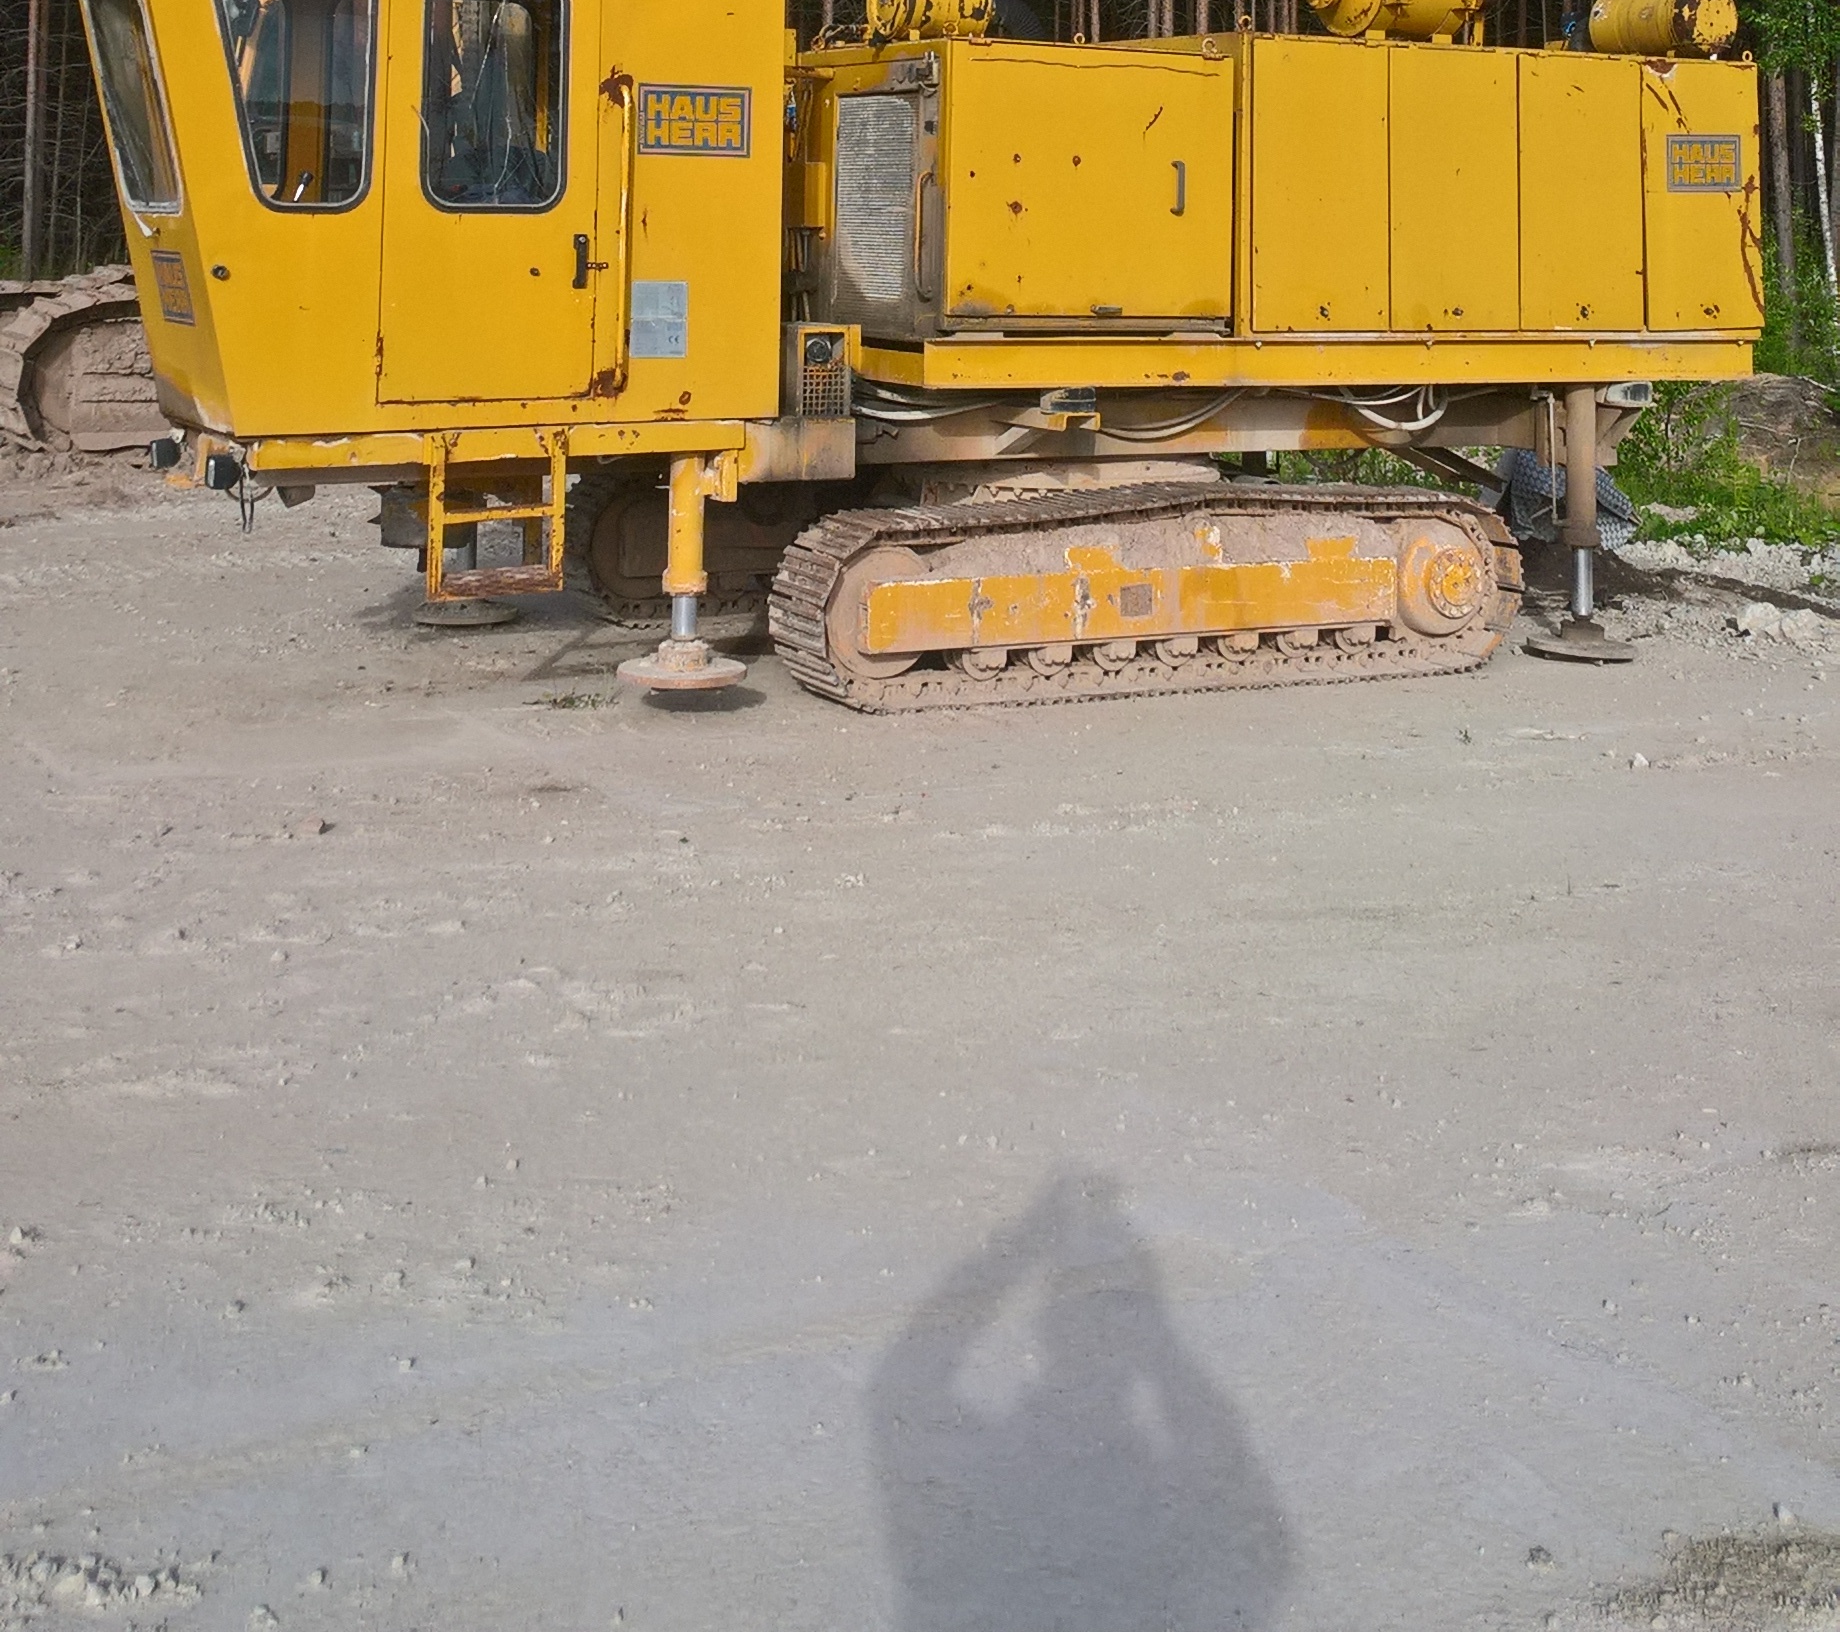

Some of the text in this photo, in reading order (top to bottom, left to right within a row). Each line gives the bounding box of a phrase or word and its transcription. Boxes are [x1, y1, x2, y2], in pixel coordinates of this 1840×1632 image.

[647, 94, 742, 121] HAUS
[647, 120, 741, 147] HERR
[1673, 144, 1735, 163] HAUS
